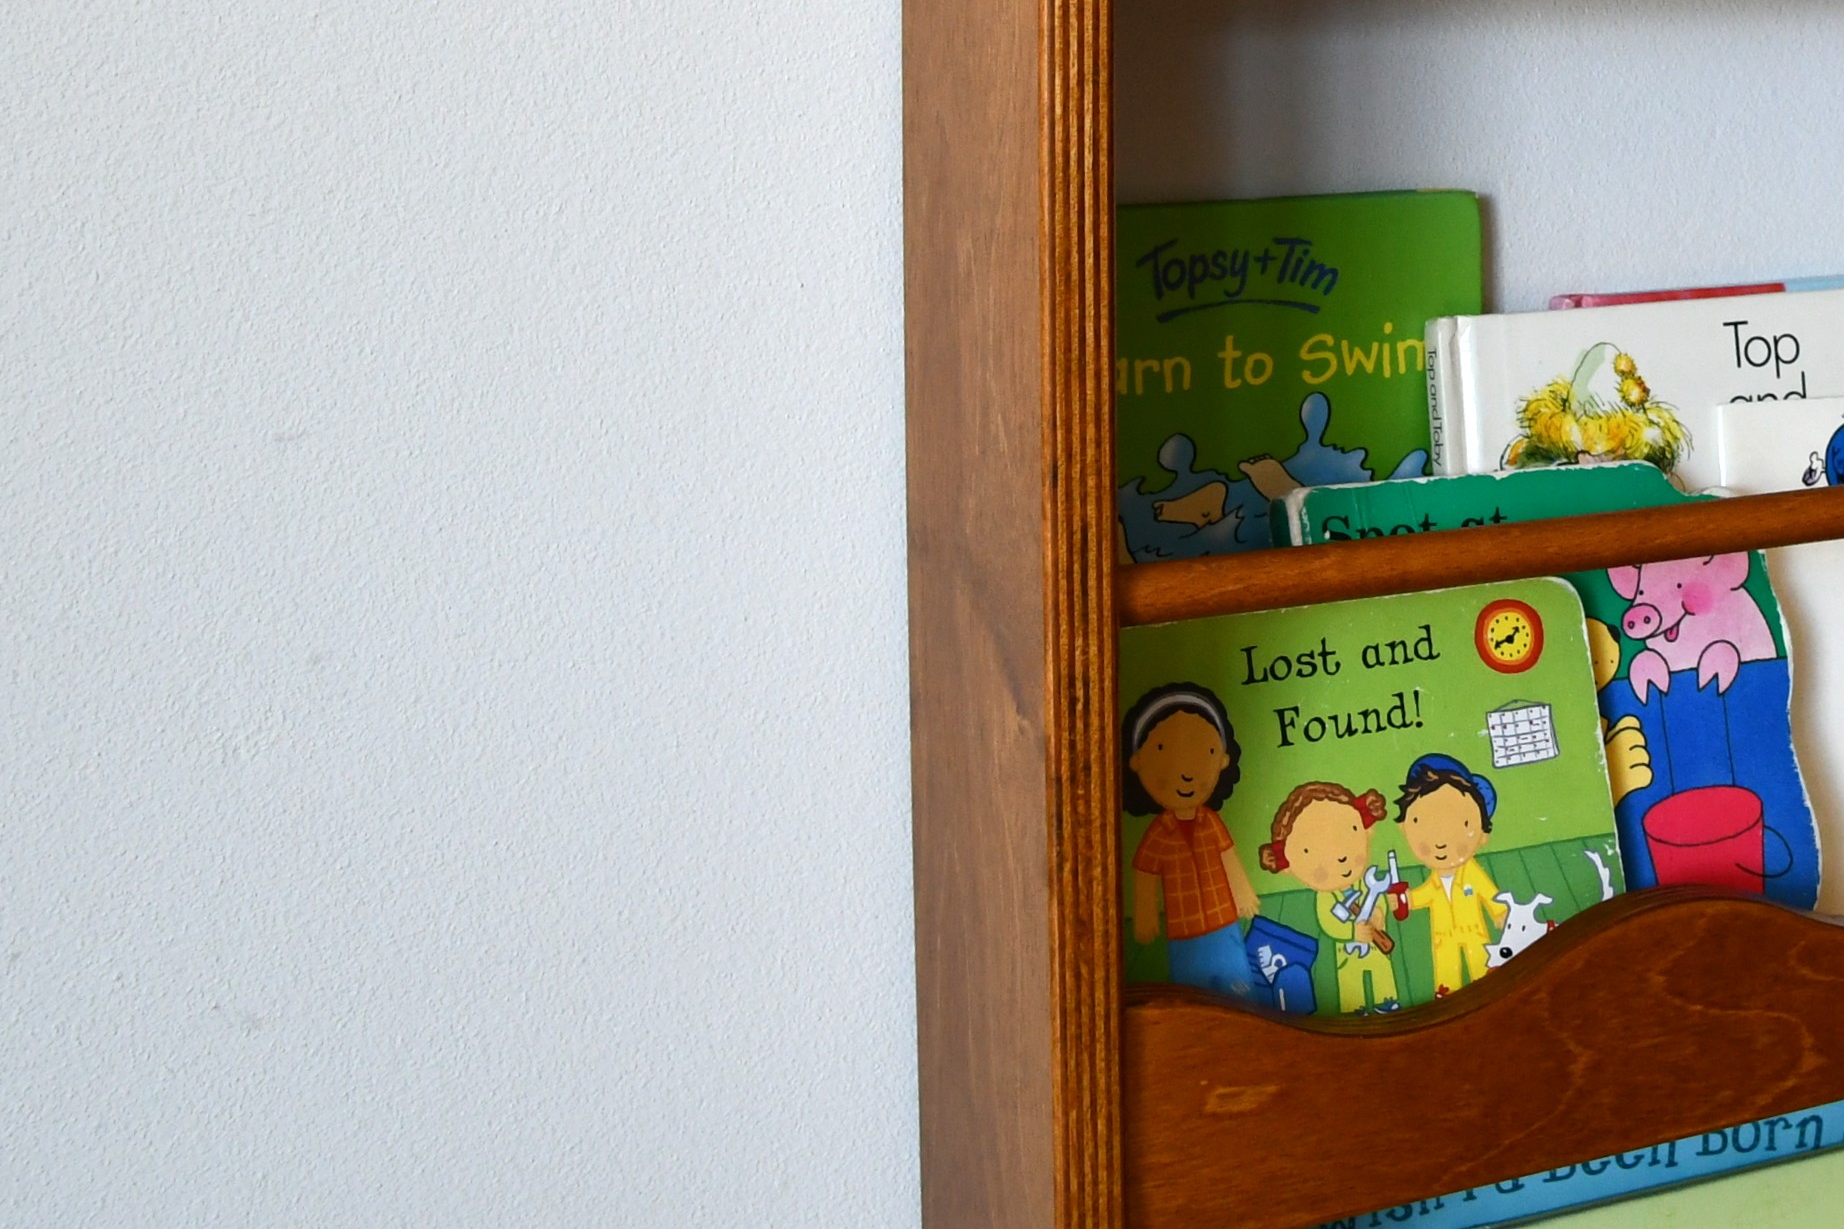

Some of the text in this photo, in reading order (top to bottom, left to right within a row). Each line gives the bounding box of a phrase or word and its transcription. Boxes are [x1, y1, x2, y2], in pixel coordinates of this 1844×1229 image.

[1113, 356, 1192, 395] arn
[1217, 335, 1273, 388] to
[1723, 321, 1800, 379] Top
[1428, 348, 1443, 467] Top and Toby
[1240, 623, 1441, 686] Lost and
[1273, 690, 1424, 748] Found!
